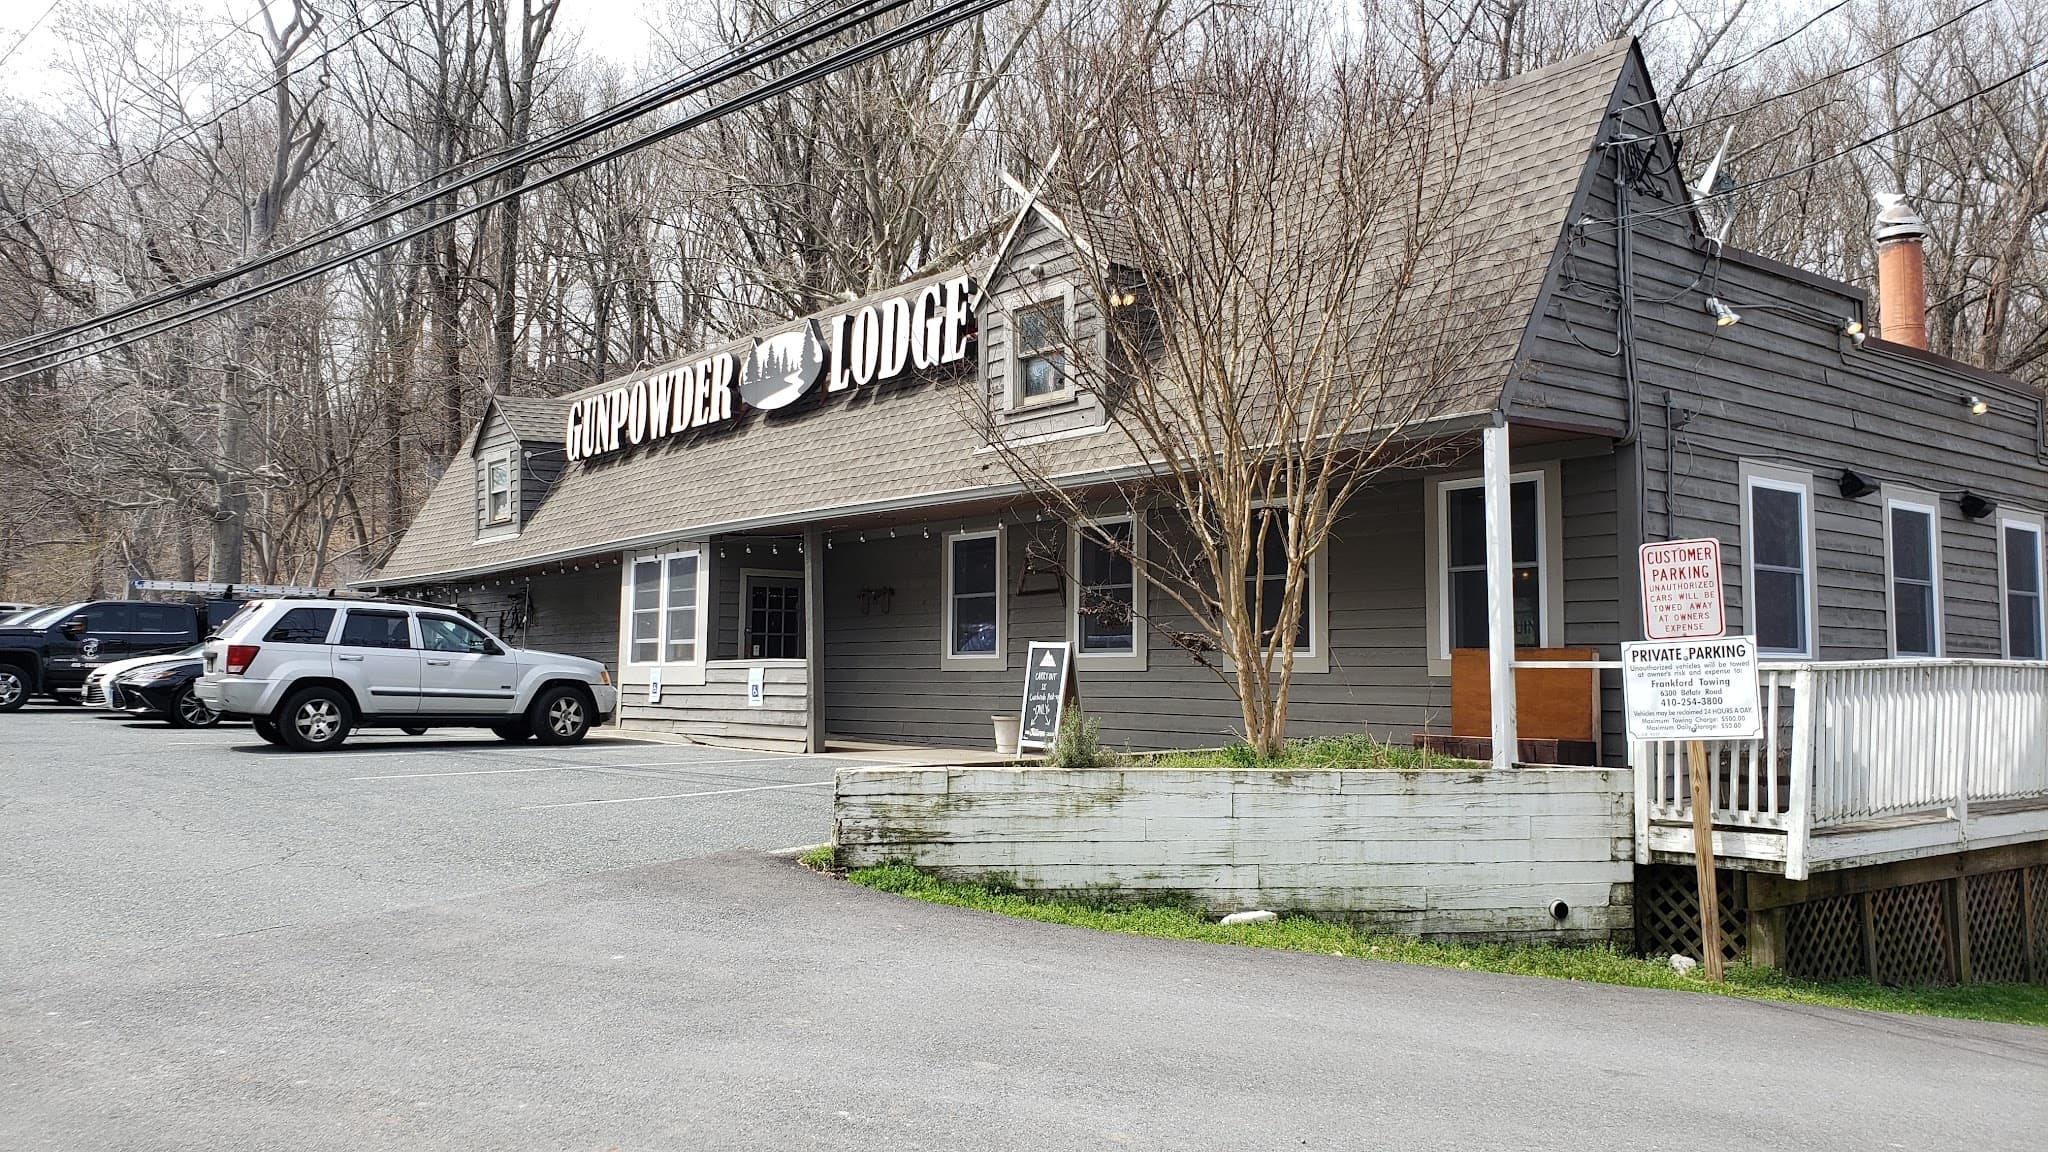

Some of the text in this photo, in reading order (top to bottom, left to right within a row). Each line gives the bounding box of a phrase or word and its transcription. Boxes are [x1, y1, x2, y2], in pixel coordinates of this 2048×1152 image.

[566, 275, 970, 462] GUNPOWDER LODGE
[1647, 547, 1712, 564] CUSTOMER
[1652, 565, 1709, 582] PARKING
[1649, 581, 1714, 592] UNAUTHORIZED
[1650, 591, 1715, 602] CARS WILL BE
[1654, 602, 1712, 612] TOWED AWAY
[1658, 612, 1710, 622] AT OWNERS
[1665, 623, 1704, 633] EXPENSE
[1632, 645, 1746, 662] PRIVATE PARKING
[1651, 677, 1730, 688] Frankford Towing
[1660, 697, 1723, 706] 410-254-3800
[1677, 708, 1703, 716] reclaimed
